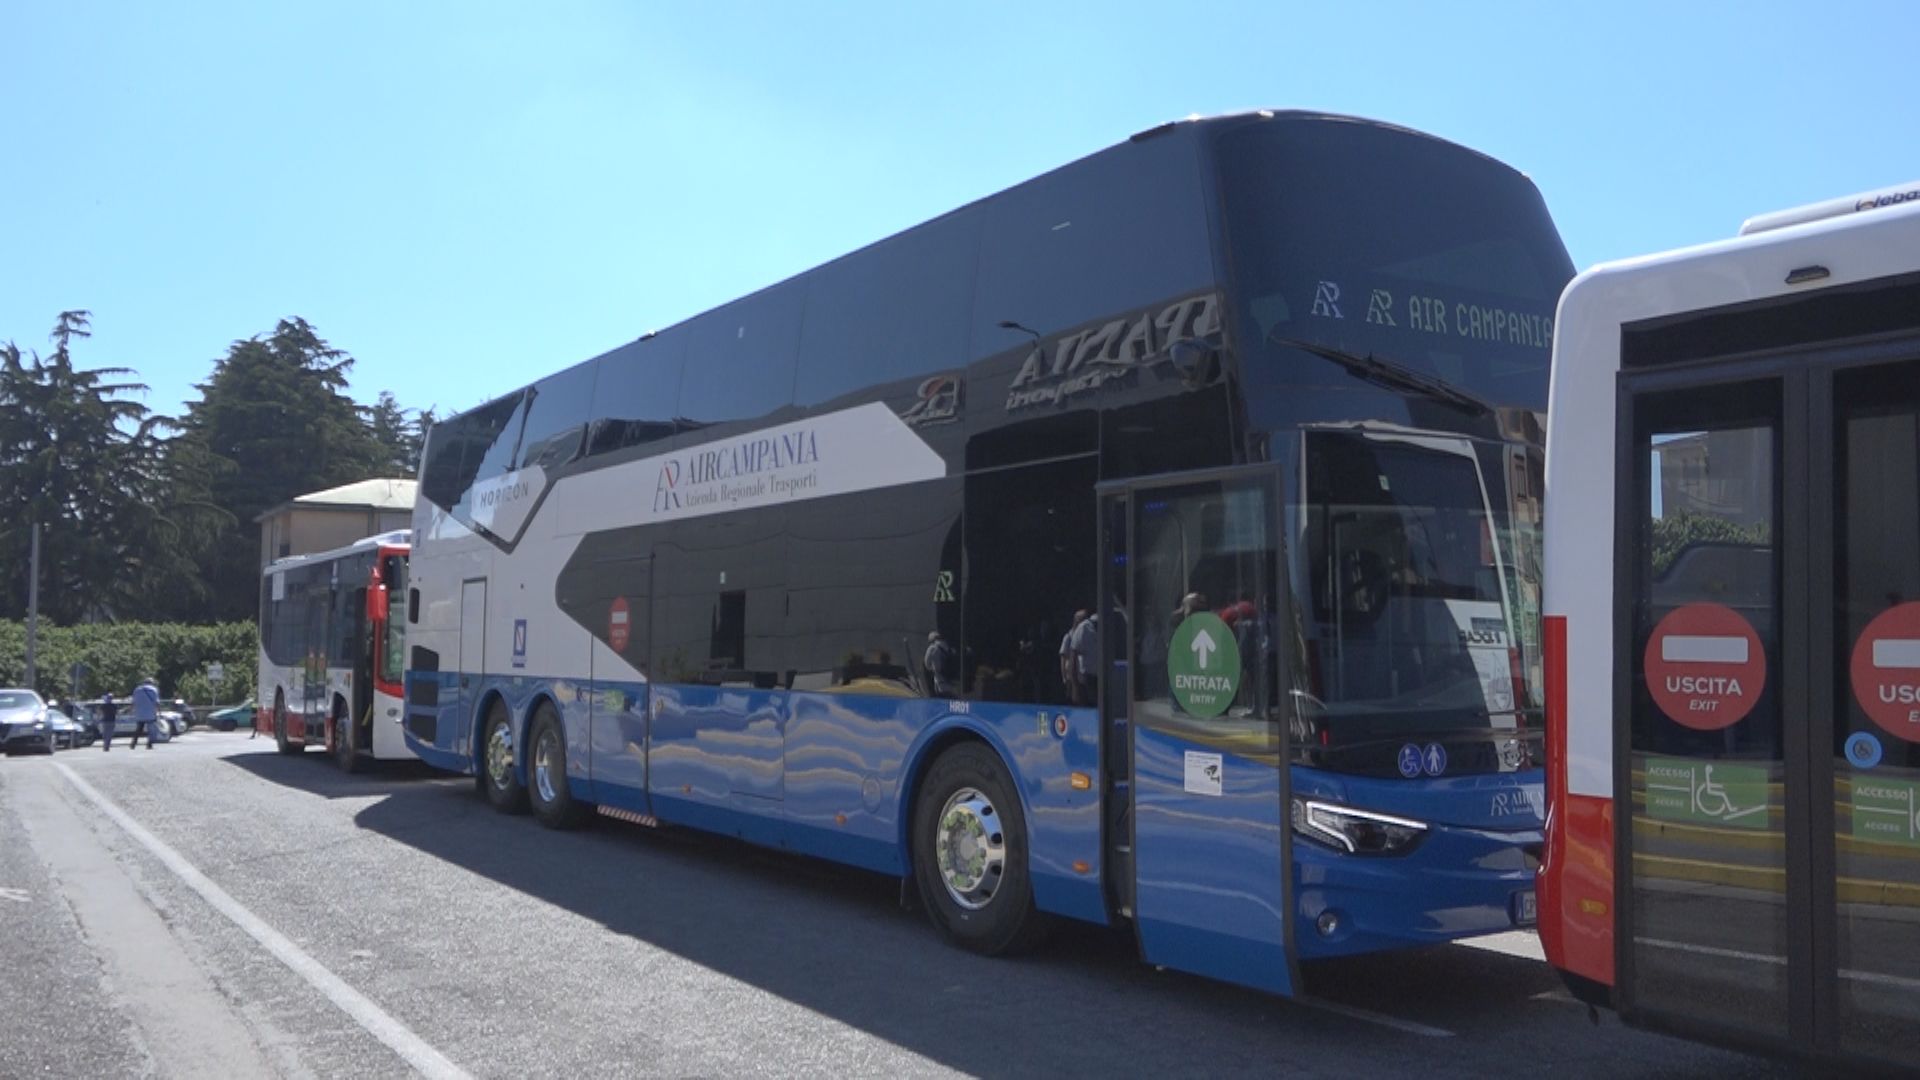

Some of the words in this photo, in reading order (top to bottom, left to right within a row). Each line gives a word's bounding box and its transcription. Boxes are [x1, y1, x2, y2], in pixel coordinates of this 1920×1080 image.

[1409, 295, 1447, 334] AIR
[1456, 303, 1551, 349] CAMPANIA
[685, 429, 819, 486] AIRCAMPANIA
[720, 478, 765, 503] Regionale
[768, 469, 818, 497] Trasporti
[1175, 674, 1232, 692] ENTRATA
[1666, 676, 1743, 696] USCITA
[1190, 693, 1216, 705] ENTRY
[1689, 699, 1719, 711] EXIT
[1649, 767, 1690, 779] ACCESSO
[1856, 786, 1908, 800] ACCESSO
